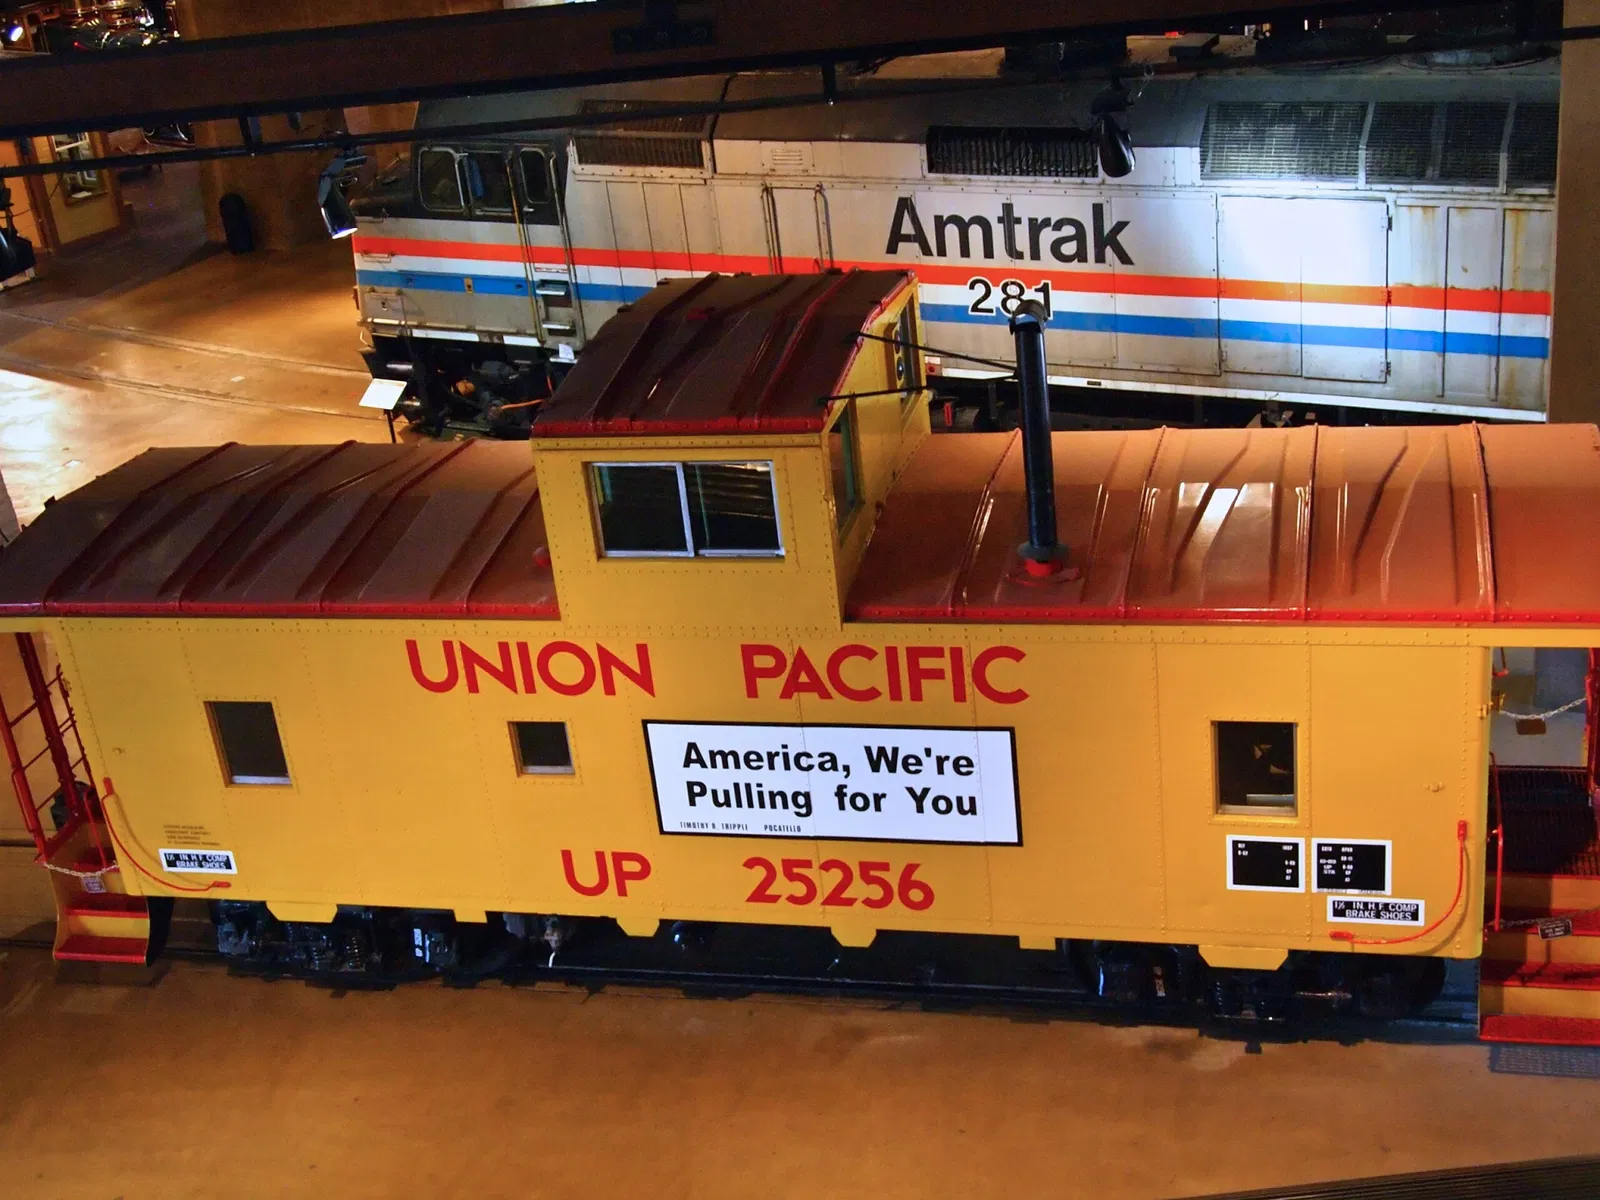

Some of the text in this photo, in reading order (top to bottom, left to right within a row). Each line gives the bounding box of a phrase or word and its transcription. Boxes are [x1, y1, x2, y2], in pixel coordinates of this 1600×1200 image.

[886, 195, 1135, 266] Amtrak
[967, 277, 1051, 318] 281
[406, 639, 1030, 705] UNION PACIFIC
[682, 742, 975, 779] America, We're
[686, 780, 978, 818] Pulling for You
[763, 824, 802, 832] POCATELLO
[176, 860, 226, 869] BRAKE SHOES
[561, 849, 935, 911] UP 25256
[1345, 909, 1412, 920] BRAKE SHOES
